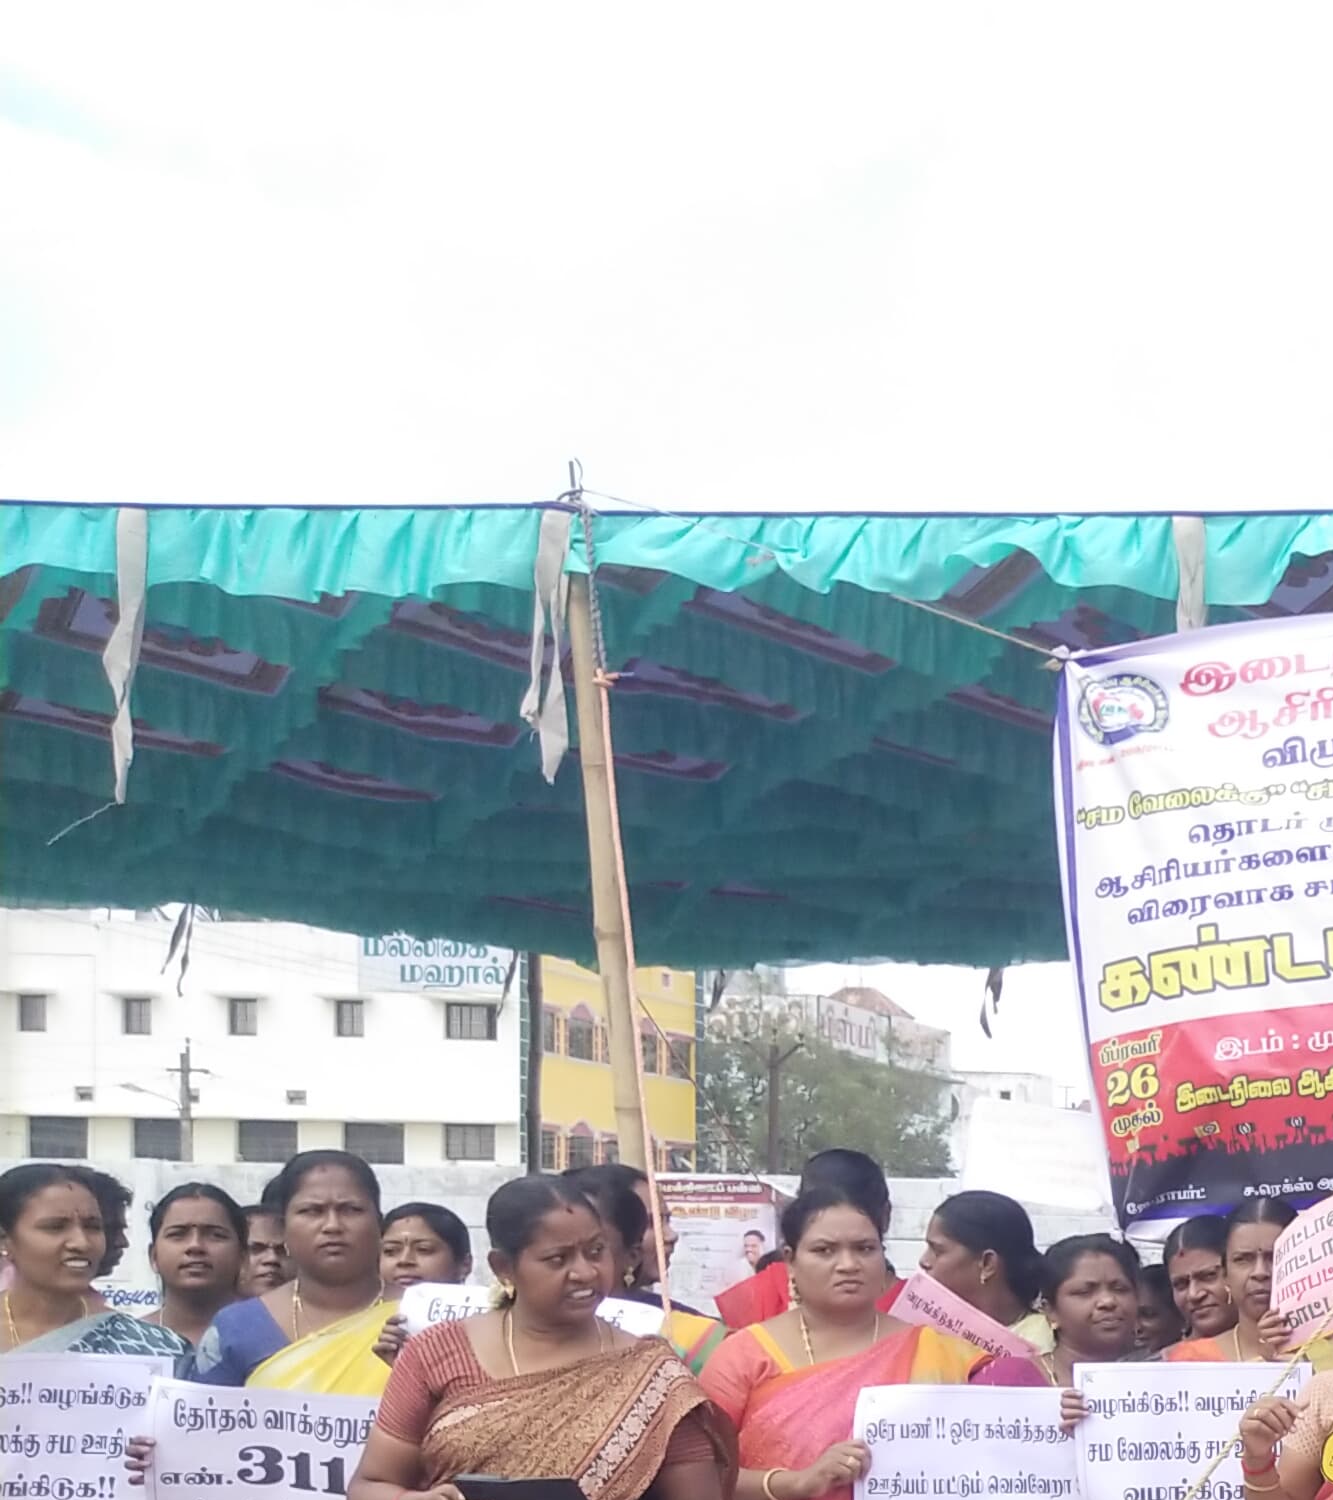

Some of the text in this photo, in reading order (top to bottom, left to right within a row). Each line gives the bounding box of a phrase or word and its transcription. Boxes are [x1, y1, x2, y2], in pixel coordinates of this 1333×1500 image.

[1188, 811, 1309, 847] தொடர்
[1127, 883, 1294, 925] விரைவாக
[400, 956, 508, 990] மஹால்
[1100, 1030, 1162, 1066] பிப்ரவரி
[1213, 1029, 1286, 1062] இடம்
[1106, 1062, 1161, 1108] 26
[1174, 1071, 1292, 1114] இடைநிலை
[1111, 1101, 1163, 1137] முதல்
[174, 1396, 257, 1434] தேர்தல்
[1088, 1390, 1189, 1419] வழங்கிடுக!!
[46, 1434, 76, 1454] சம
[865, 1419, 896, 1445] ஒரே
[900, 1416, 932, 1440] பணி
[950, 1419, 980, 1445] ஒரே
[1087, 1442, 1112, 1462] சம
[1117, 1431, 1201, 1463] வேலைக்கு
[0, 1473, 116, 1500] ங்கிடுக!!
[867, 1470, 929, 1498] ஊதியம்
[932, 1470, 984, 1498] மட்டும்
